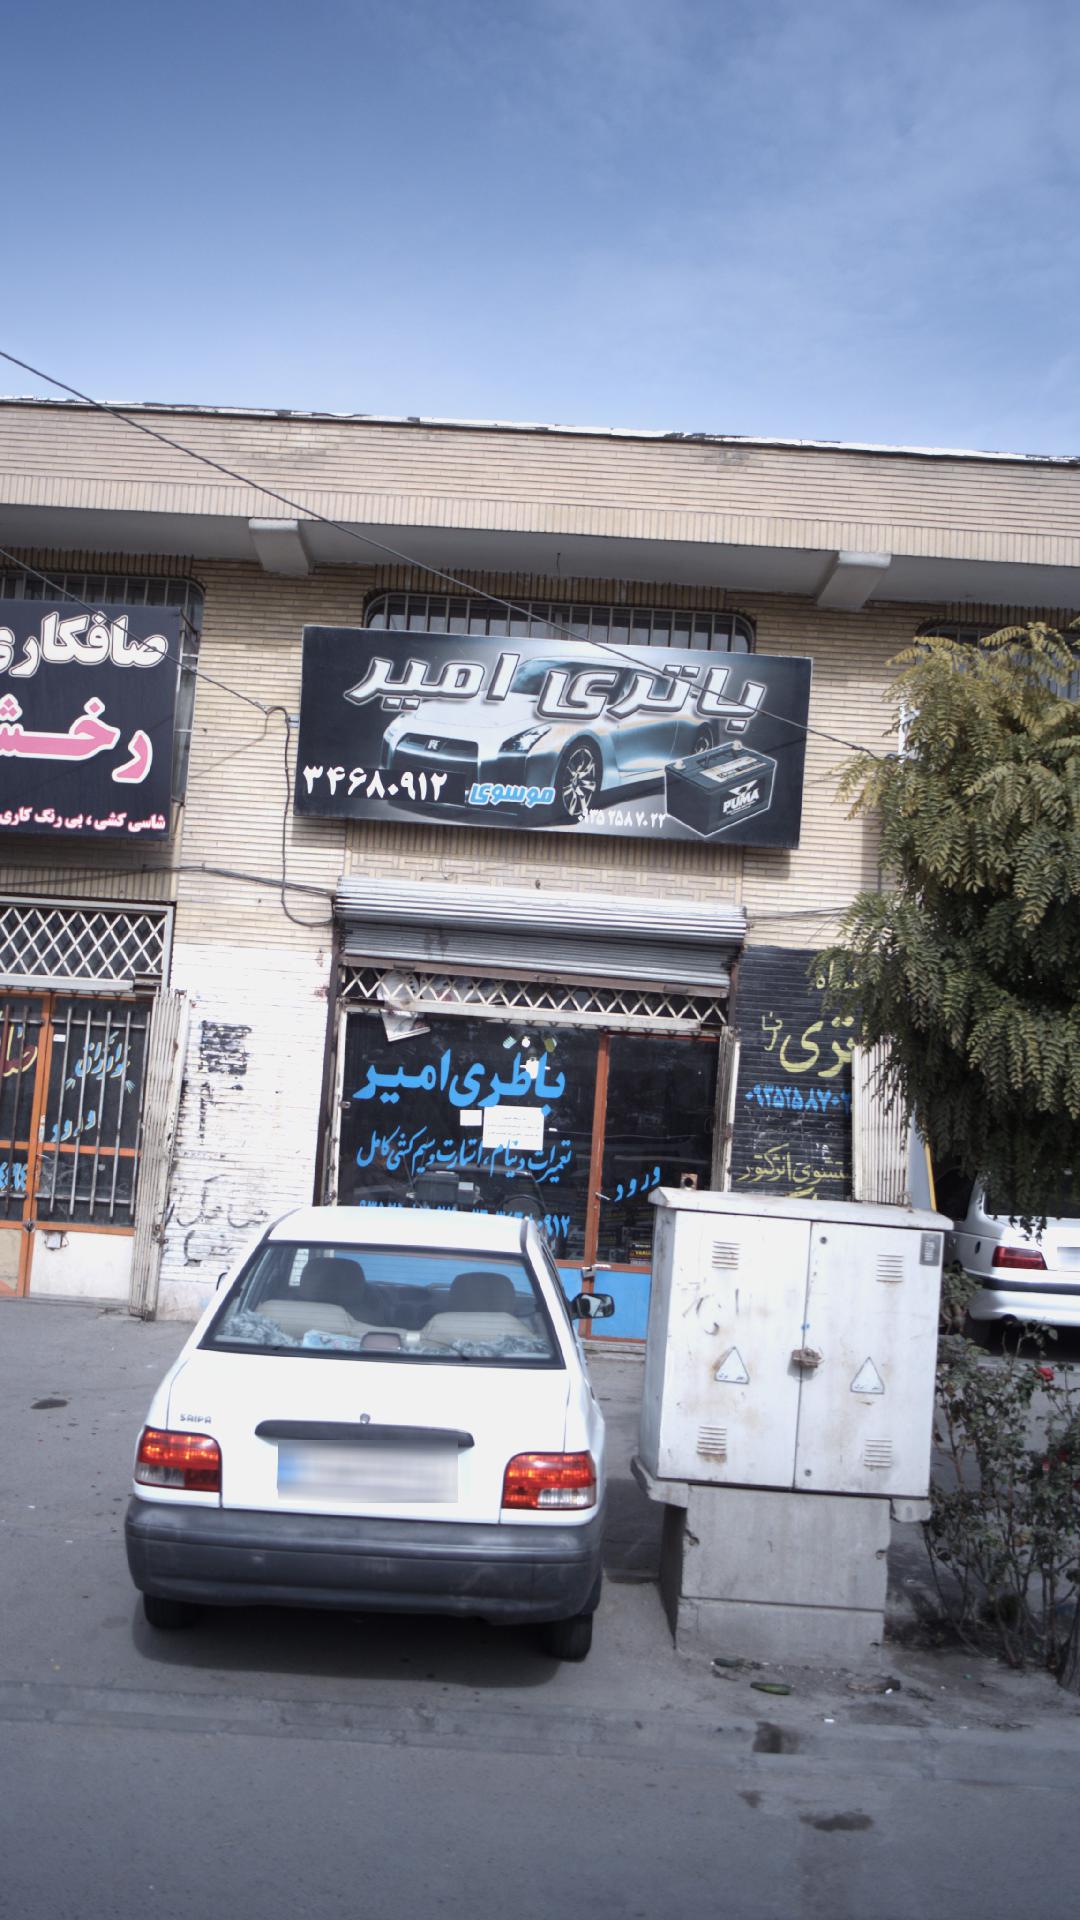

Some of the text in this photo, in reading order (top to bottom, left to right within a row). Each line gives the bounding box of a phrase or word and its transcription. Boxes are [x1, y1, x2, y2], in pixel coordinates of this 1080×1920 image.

[345, 652, 766, 731] باتری امیر
[468, 783, 556, 808] موسوی
[722, 788, 760, 813] PUMA
[34, 808, 63, 827] رنگ
[64, 814, 83, 829] بی
[94, 812, 127, 830] کشی
[128, 813, 166, 832] شاسی
[353, 1049, 566, 1117] باطری امیر
[527, 1139, 572, 1183] تعمیرات
[614, 1166, 660, 1202] ورود
[180, 1413, 212, 1424] SAIPA
